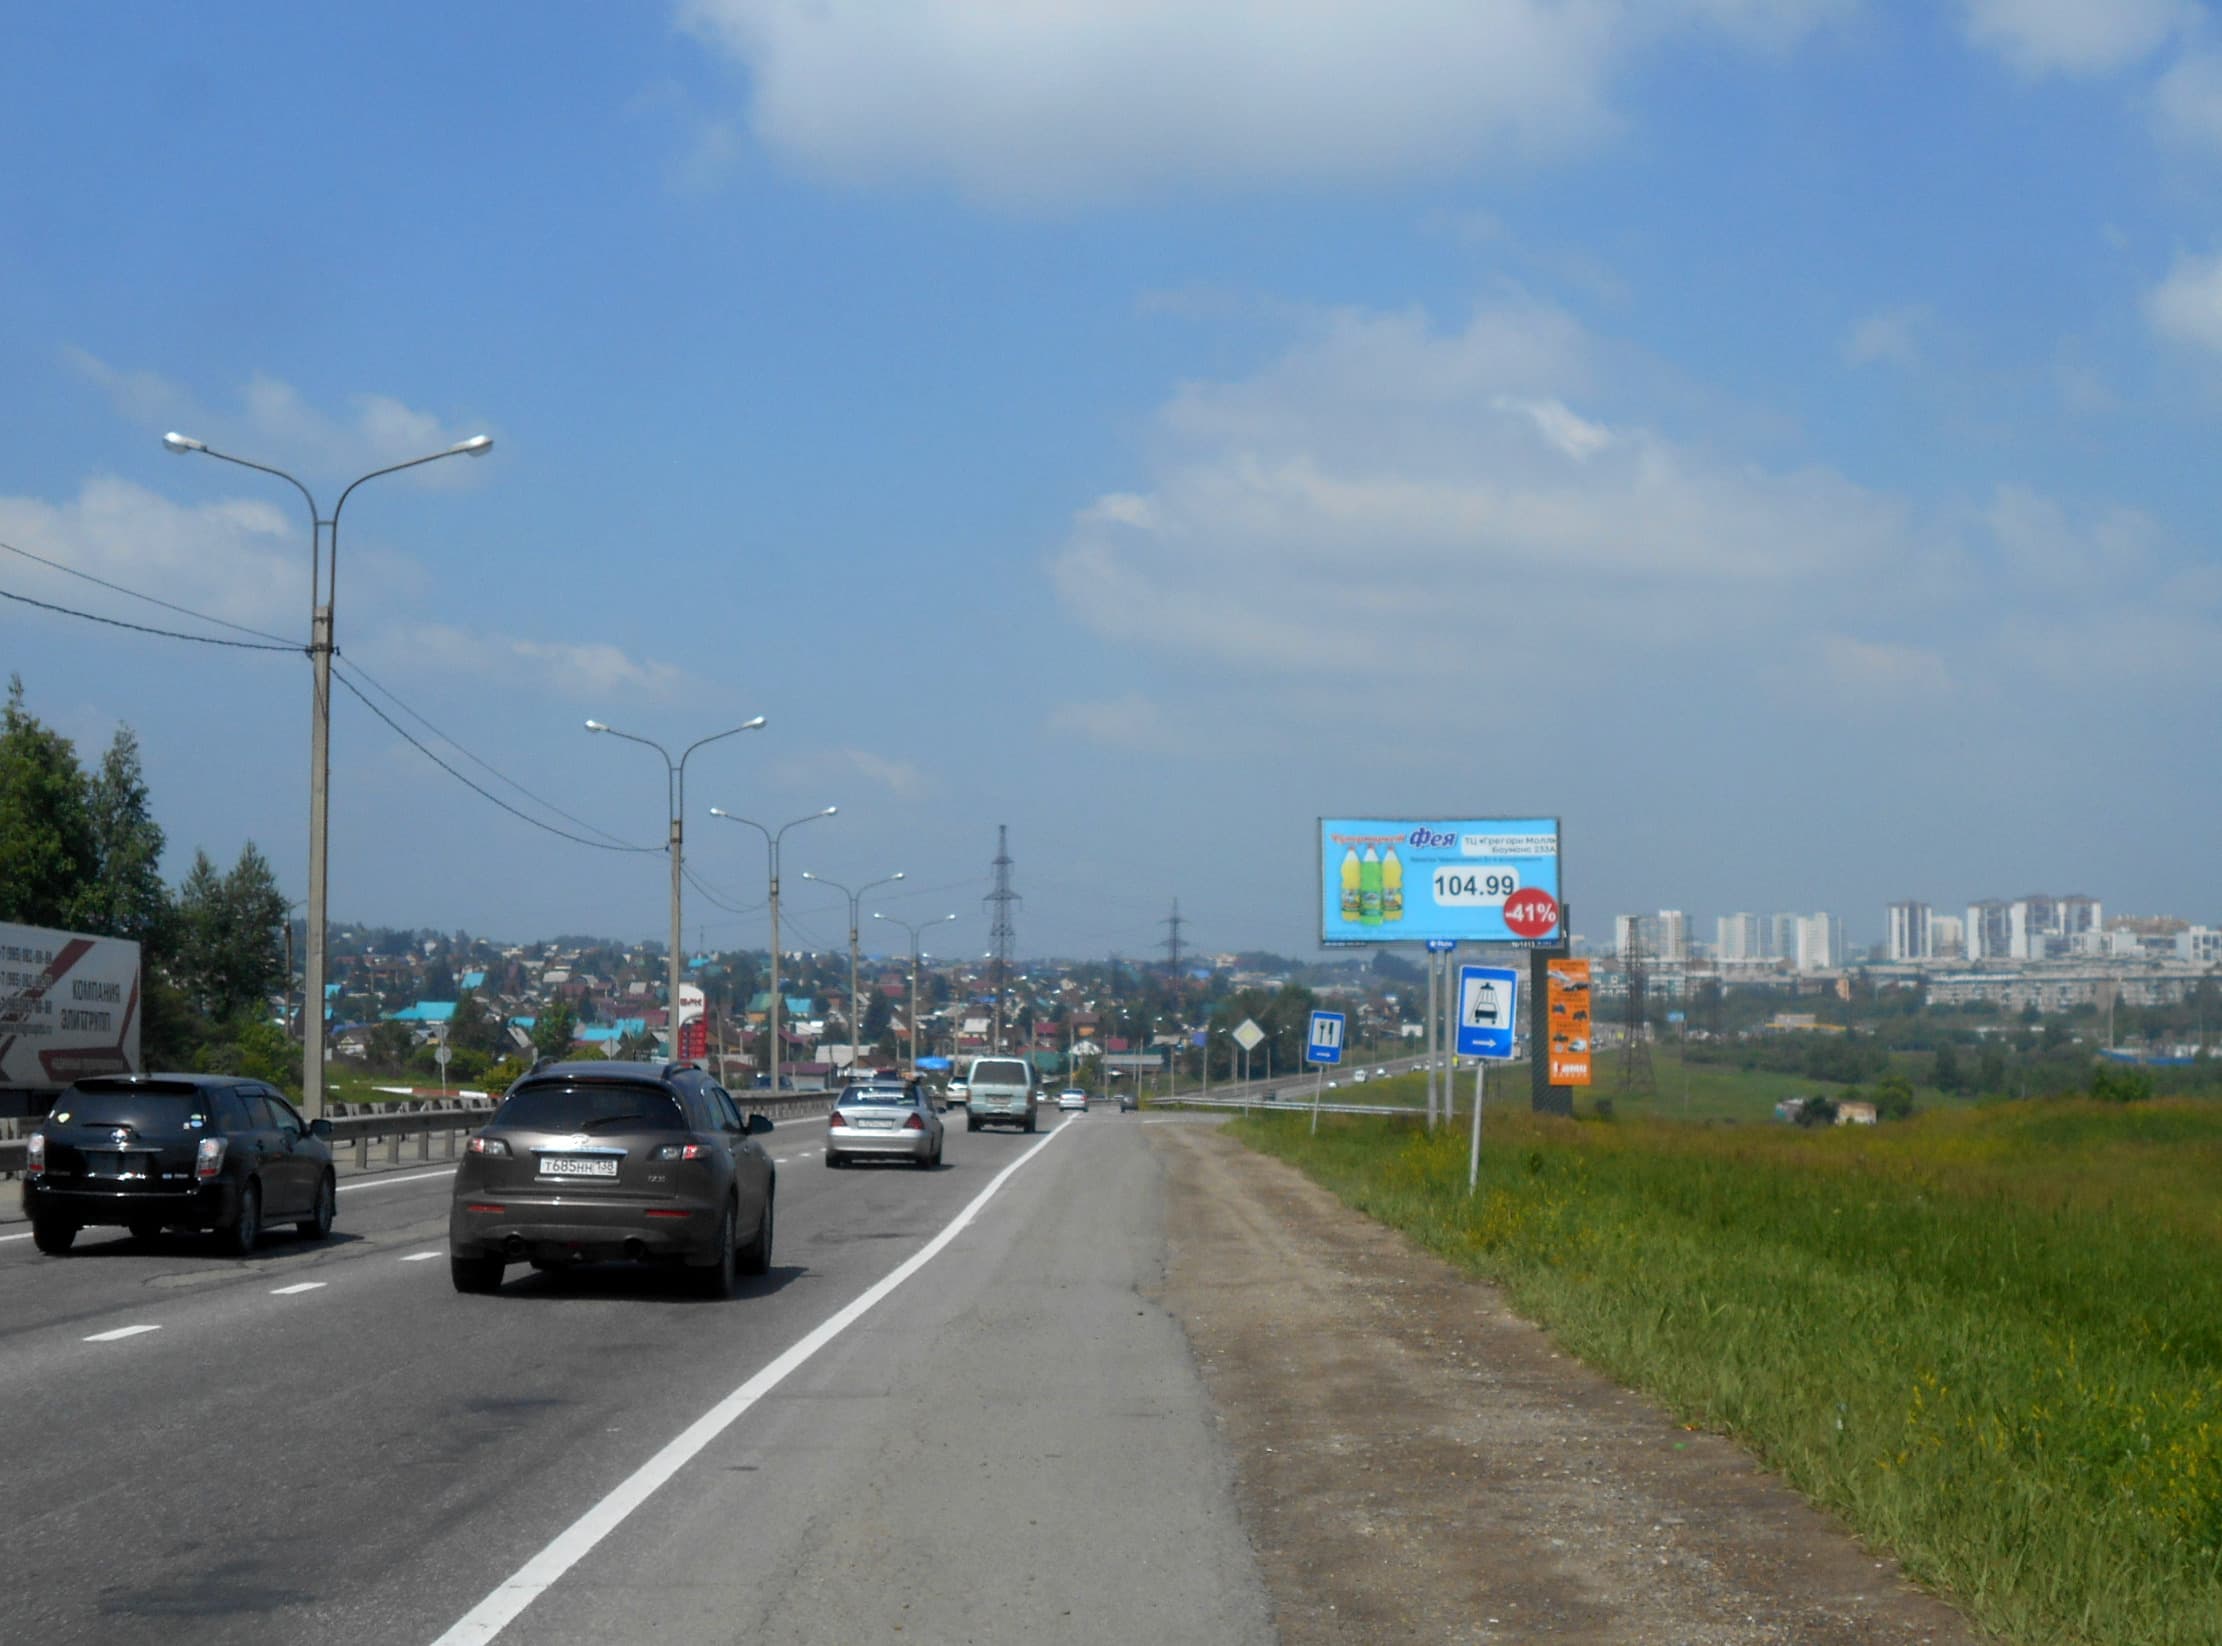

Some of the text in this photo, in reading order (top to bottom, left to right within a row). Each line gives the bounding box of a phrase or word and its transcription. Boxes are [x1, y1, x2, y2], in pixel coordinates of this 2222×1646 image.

[1409, 827, 1457, 848] Фея
[1434, 875, 1515, 896] 104.99
[1505, 902, 1557, 922] -41%
[72, 980, 121, 1003] КОМПАНИЯ
